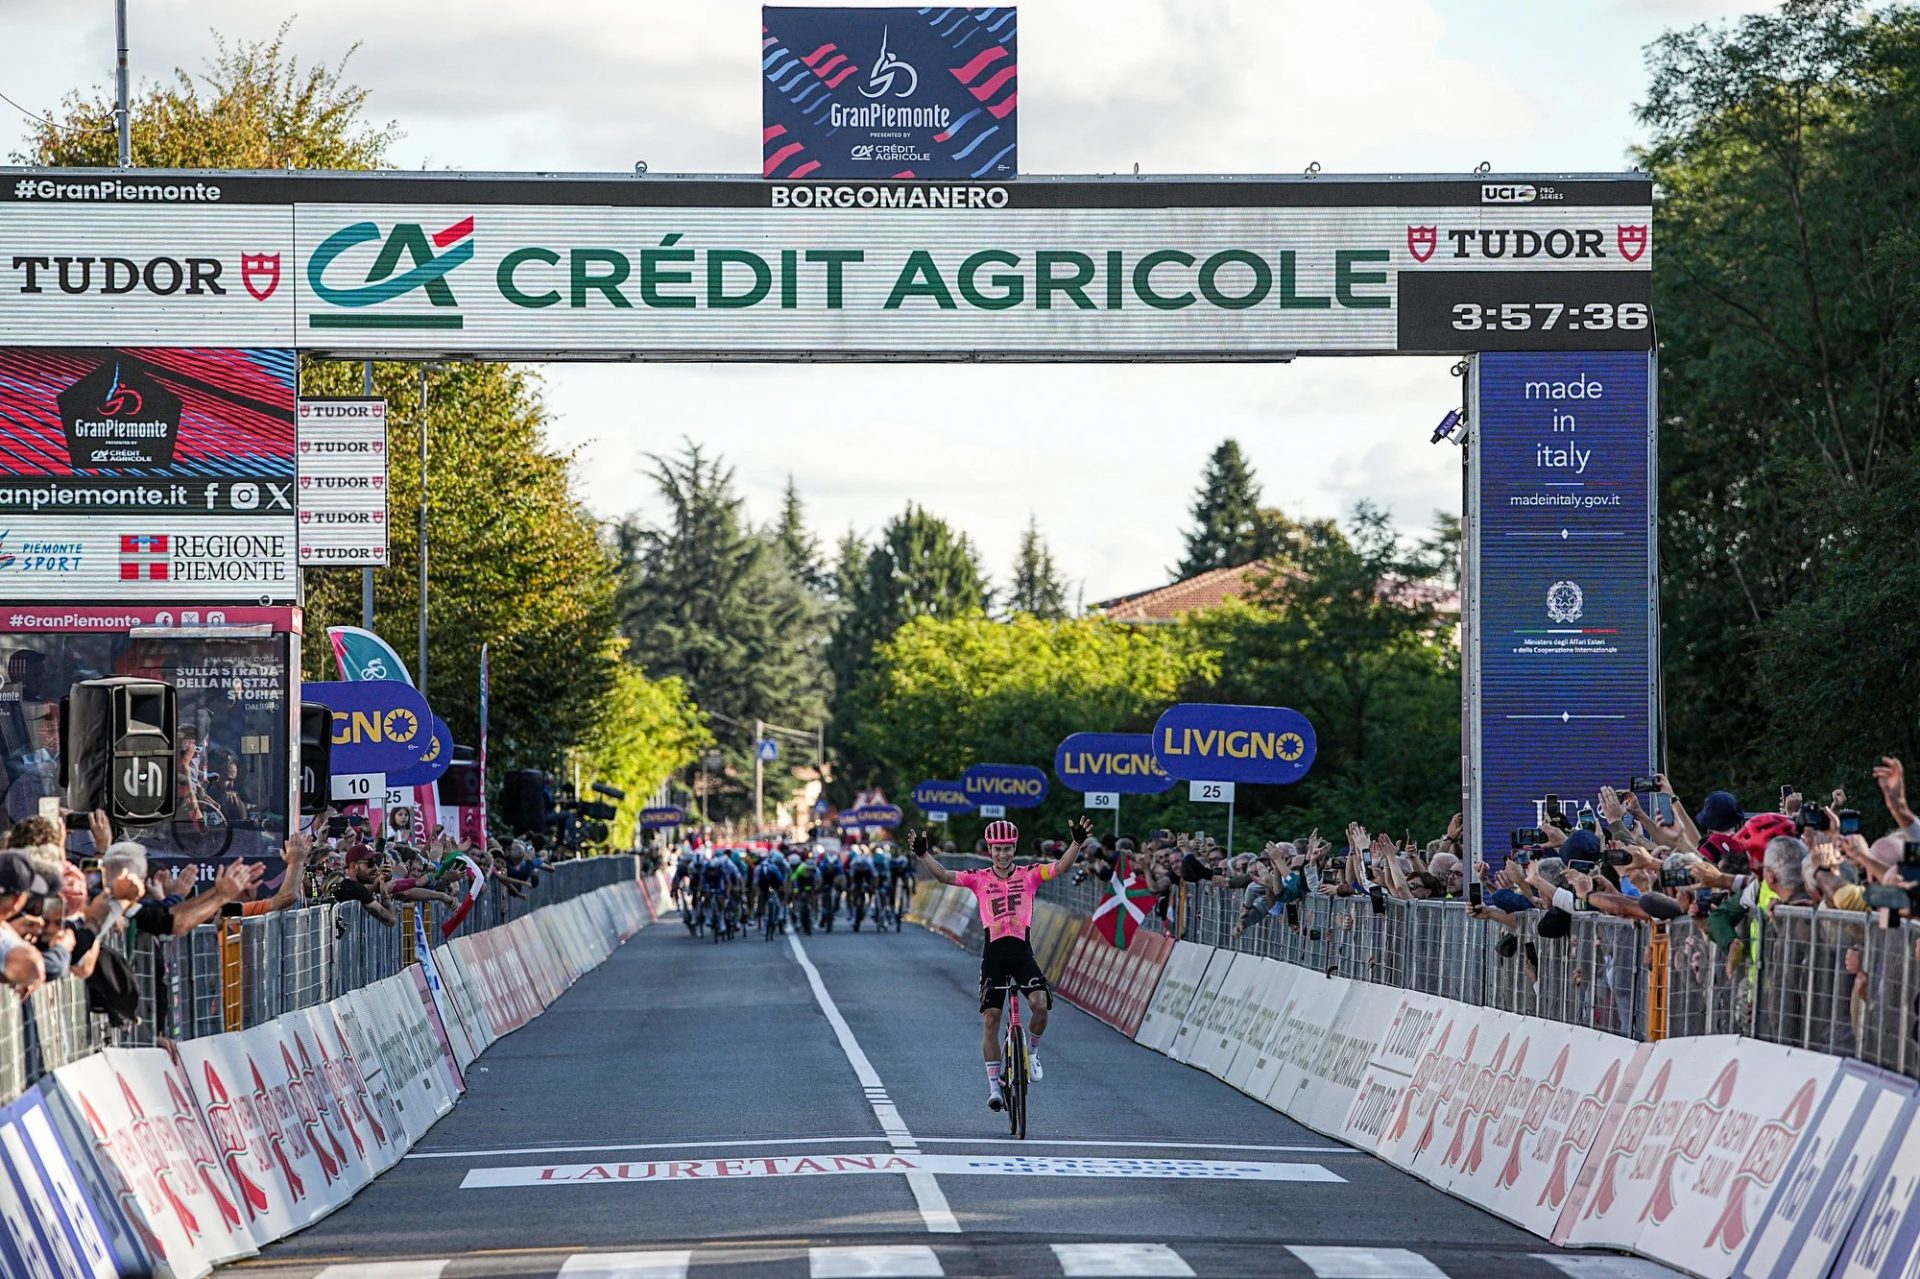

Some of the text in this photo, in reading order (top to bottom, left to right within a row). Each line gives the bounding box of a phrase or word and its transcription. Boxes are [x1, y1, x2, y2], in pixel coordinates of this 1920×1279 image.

[831, 104, 950, 128] GranPiemonte
[875, 144, 915, 153] CRÉDIT
[875, 153, 930, 161] AGRICOLE
[14, 180, 221, 201] #GranPiemonte
[771, 186, 1009, 208] BORGOMANERO
[1485, 187, 1515, 199] UCI
[1448, 229, 1606, 258] TUDOR
[13, 256, 226, 295] TUDOR
[497, 233, 864, 309] CRÉDIT
[883, 249, 1391, 311] AGRICOLE
[1451, 303, 1648, 331] 3:57:36
[1525, 373, 1602, 400] made
[314, 406, 368, 417] TUDOR
[1553, 408, 1576, 432] in
[75, 419, 167, 438] GranPiemonte
[314, 441, 368, 453] TUDOR
[1536, 442, 1591, 473] italy
[314, 477, 369, 488] TUDOR
[1510, 493, 1621, 508] madeinitaly.gov.it
[315, 512, 370, 524] TUDOR
[22, 543, 83, 553] PIEMONTE
[174, 535, 285, 558] REGIONE
[315, 547, 370, 559] TUDOR
[23, 557, 83, 571] SPORT
[174, 561, 285, 581] PIEMONTE
[9, 614, 141, 628] #GranPiemonte
[176, 667, 279, 676] SULLA STRADA
[176, 678, 279, 688] DELLA NOSTRA
[227, 690, 279, 700] STORIA
[1164, 727, 1305, 762] LIVIGNO
[348, 778, 369, 795] 10
[966, 777, 1042, 795] LIVIGNO
[1203, 785, 1221, 798] 25
[386, 791, 401, 803] 25
[1095, 795, 1109, 806] 50
[991, 893, 1022, 916] EF
[1388, 1003, 1434, 1060] TUDOR
[1353, 1081, 1397, 1136] TUDOR
[536, 1156, 921, 1181] LAURETANA
